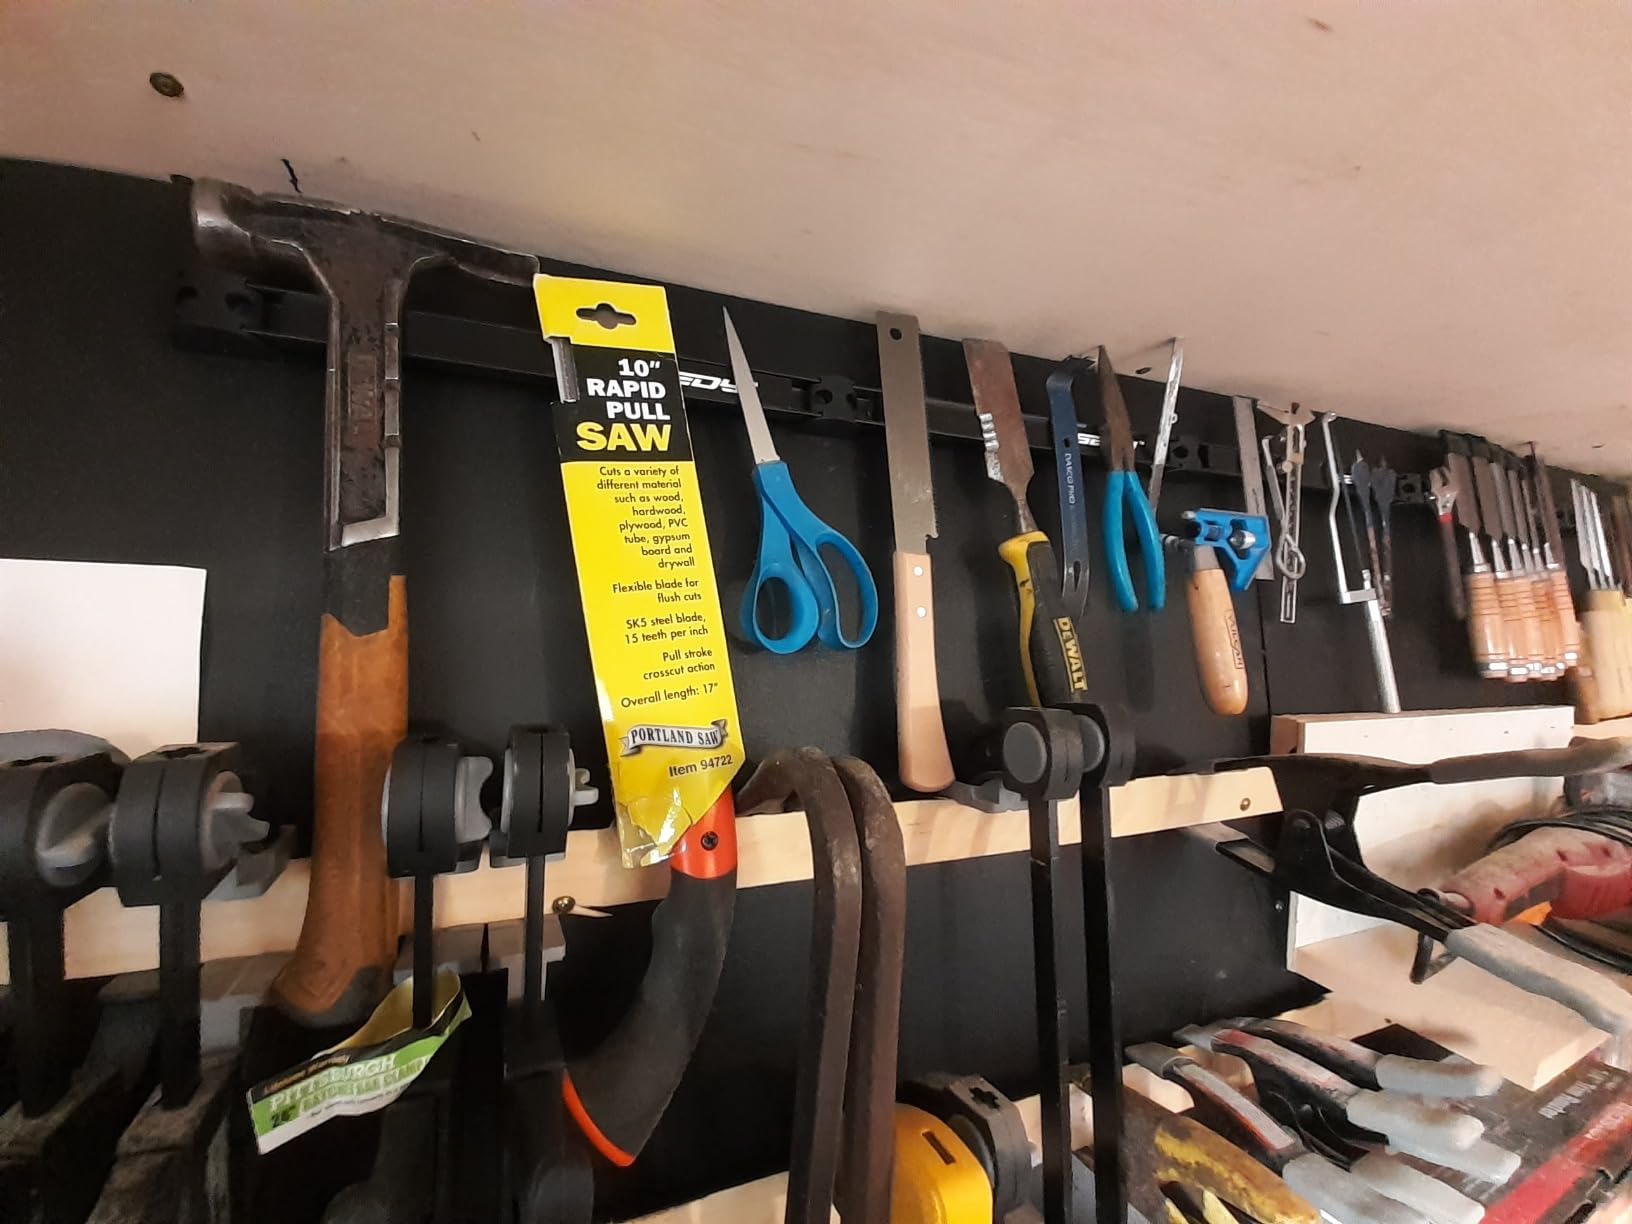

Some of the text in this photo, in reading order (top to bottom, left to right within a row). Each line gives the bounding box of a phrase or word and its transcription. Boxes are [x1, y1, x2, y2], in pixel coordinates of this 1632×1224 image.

[618, 358, 661, 377] 10"
[586, 378, 666, 399] RAPID
[606, 401, 671, 420] PULL
[576, 421, 672, 452] SAW
[599, 466, 621, 476] Cuts
[634, 466, 667, 478] variety
[670, 465, 680, 476] of
[596, 478, 682, 490] different material
[614, 492, 684, 503] such as wood,
[632, 505, 686, 516] hardwood,
[619, 518, 688, 533] plywood, PVC
[624, 533, 690, 545] tube, gypsum
[641, 544, 692, 556] board and
[658, 556, 695, 570] drywall
[612, 577, 699, 593] Flexible blade for
[657, 592, 702, 603] flush cuts
[626, 611, 706, 630] SK5 steel blade,
[625, 625, 709, 644] 15 teeth per inch
[662, 646, 713, 662] Pull stroke
[643, 662, 715, 680] crosscut action
[620, 682, 718, 708] Overall length: 17"
[631, 728, 719, 745] PORTLAND SAW
[668, 754, 733, 777] Item 94722
